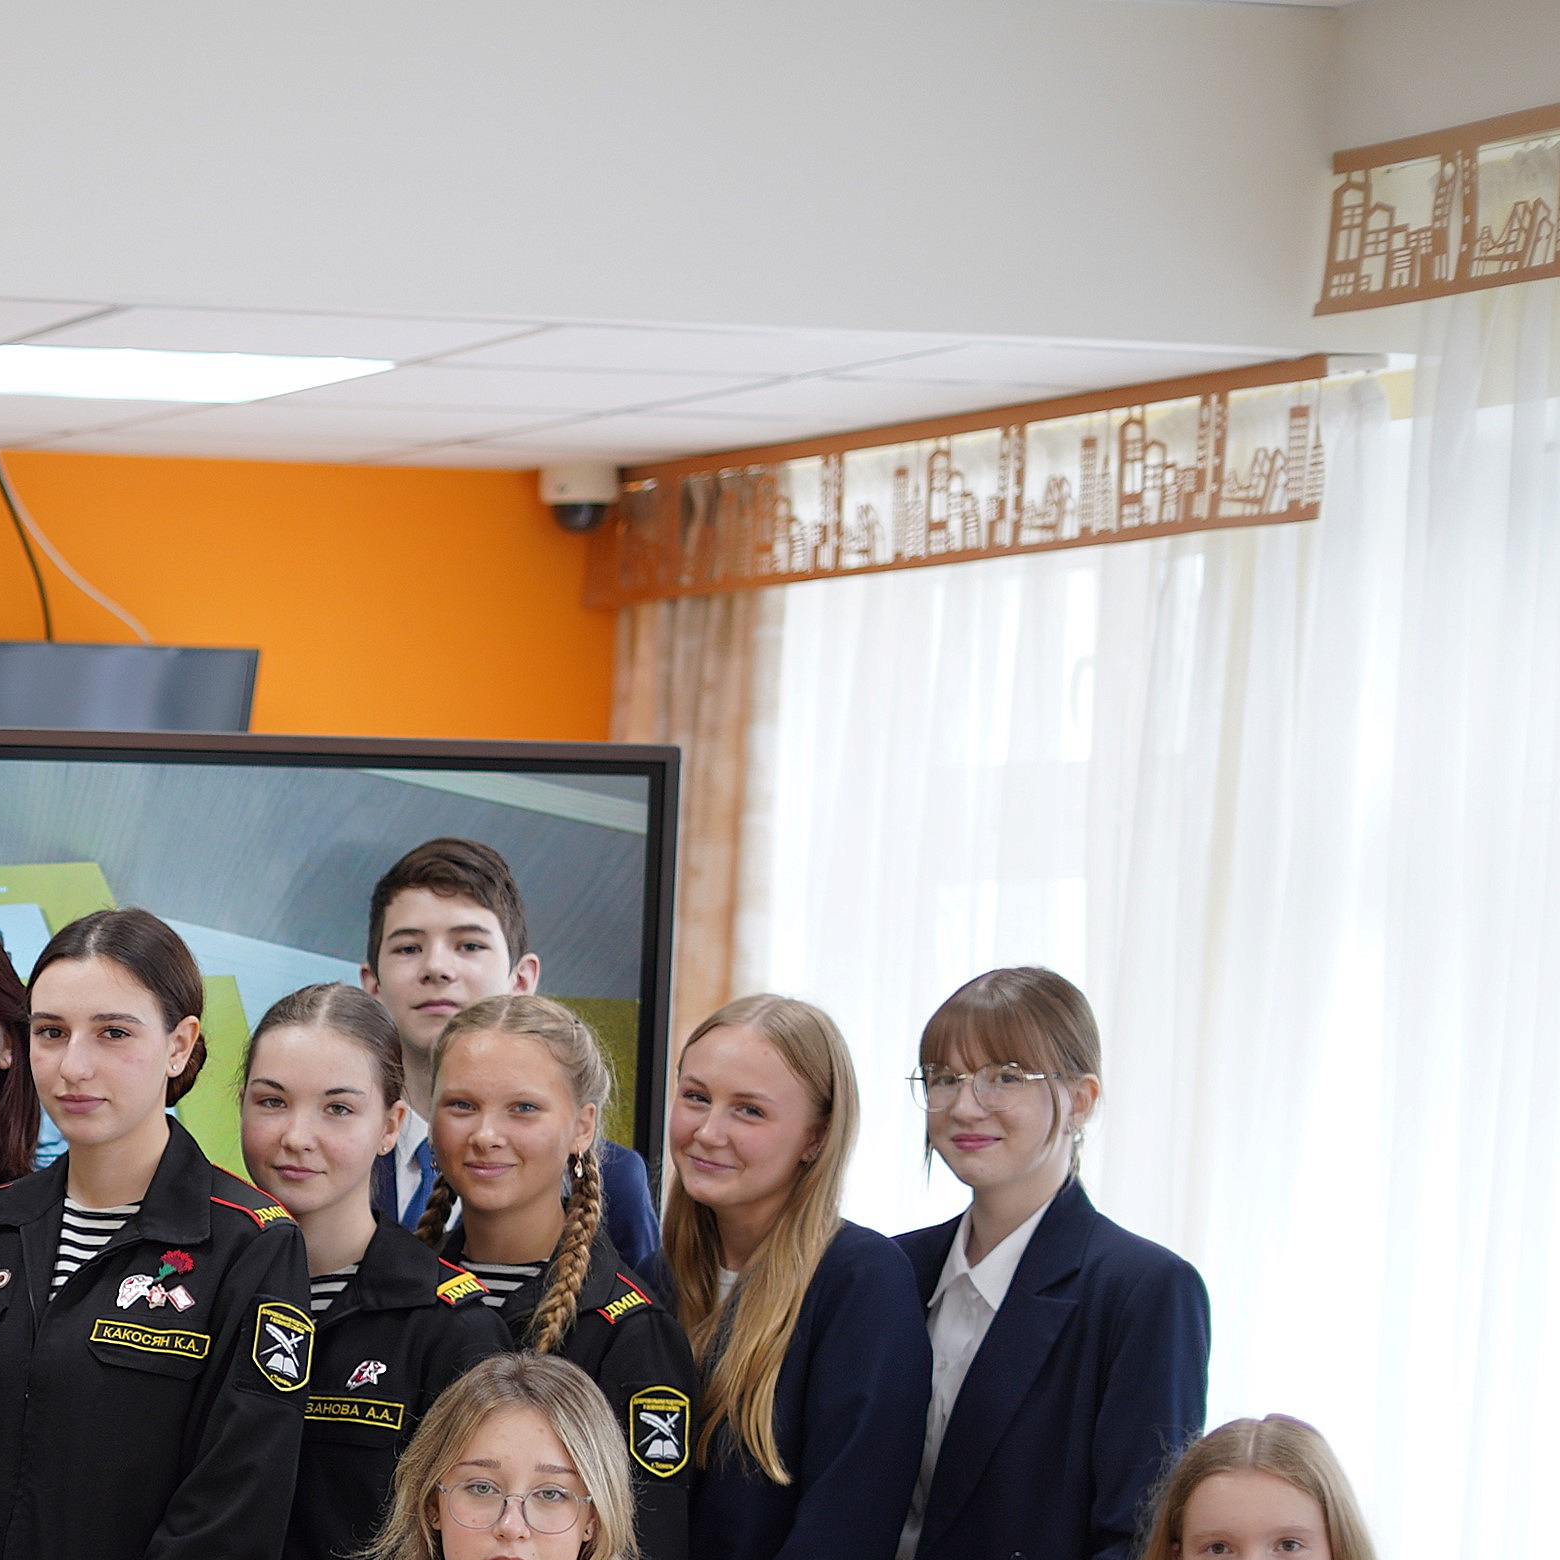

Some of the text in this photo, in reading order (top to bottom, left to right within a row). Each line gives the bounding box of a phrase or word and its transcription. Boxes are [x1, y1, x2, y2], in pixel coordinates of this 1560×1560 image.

[604, 1290, 647, 1321] ДМЦ
[103, 1326, 200, 1353] КАКОСЯН К.А.
[304, 1402, 395, 1422] ЗАНОВА А.А.
